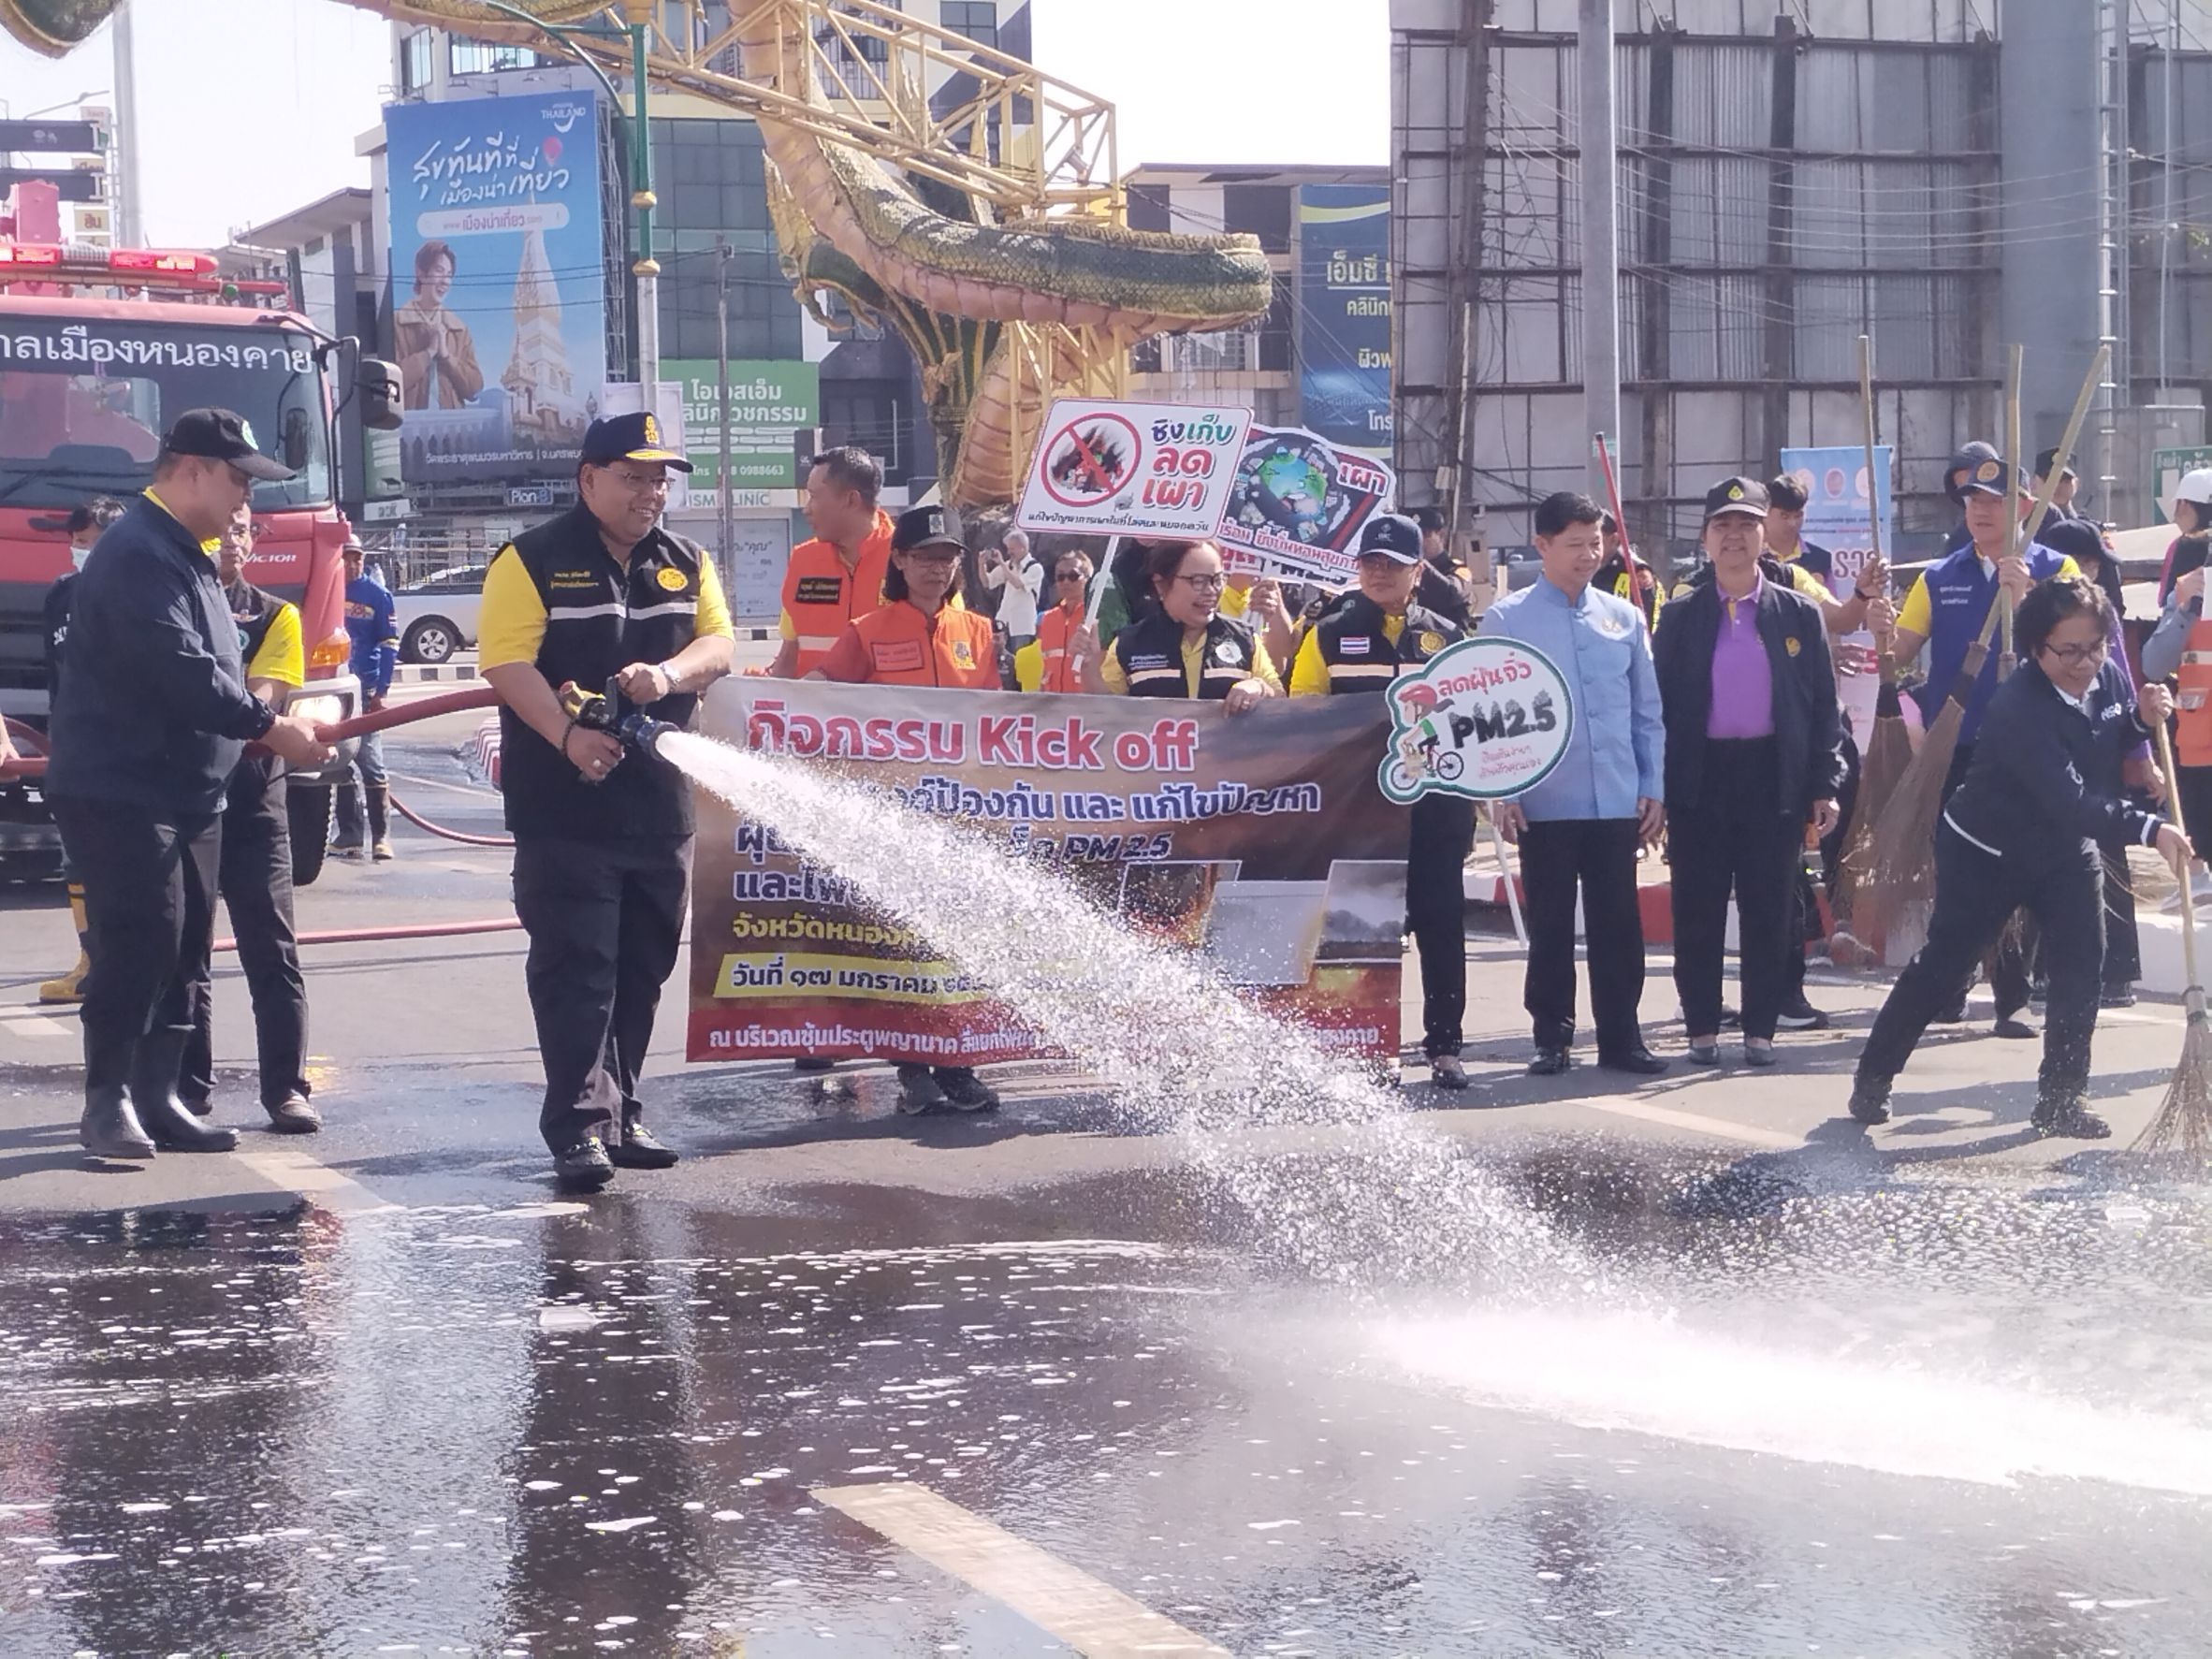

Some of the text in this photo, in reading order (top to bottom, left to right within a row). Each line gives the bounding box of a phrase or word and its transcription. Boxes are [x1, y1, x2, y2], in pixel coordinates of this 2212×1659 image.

[541, 107, 586, 120] THAILAND
[1152, 445, 1216, 476] ลด
[1141, 476, 1210, 511] เผา
[1338, 463, 1388, 496] เผา
[511, 489, 538, 503] Plan
[689, 493, 770, 506] ISM LINIC
[1448, 690, 1557, 749] PM2.5
[748, 700, 1200, 772] กิจกรรม Kick off
[1063, 793, 1124, 822] และ
[1131, 783, 1321, 822] แก้ไขปัญหา
[1063, 836, 1121, 862] PM
[733, 956, 784, 988] วันที่
[790, 968, 833, 988] ๑๗
